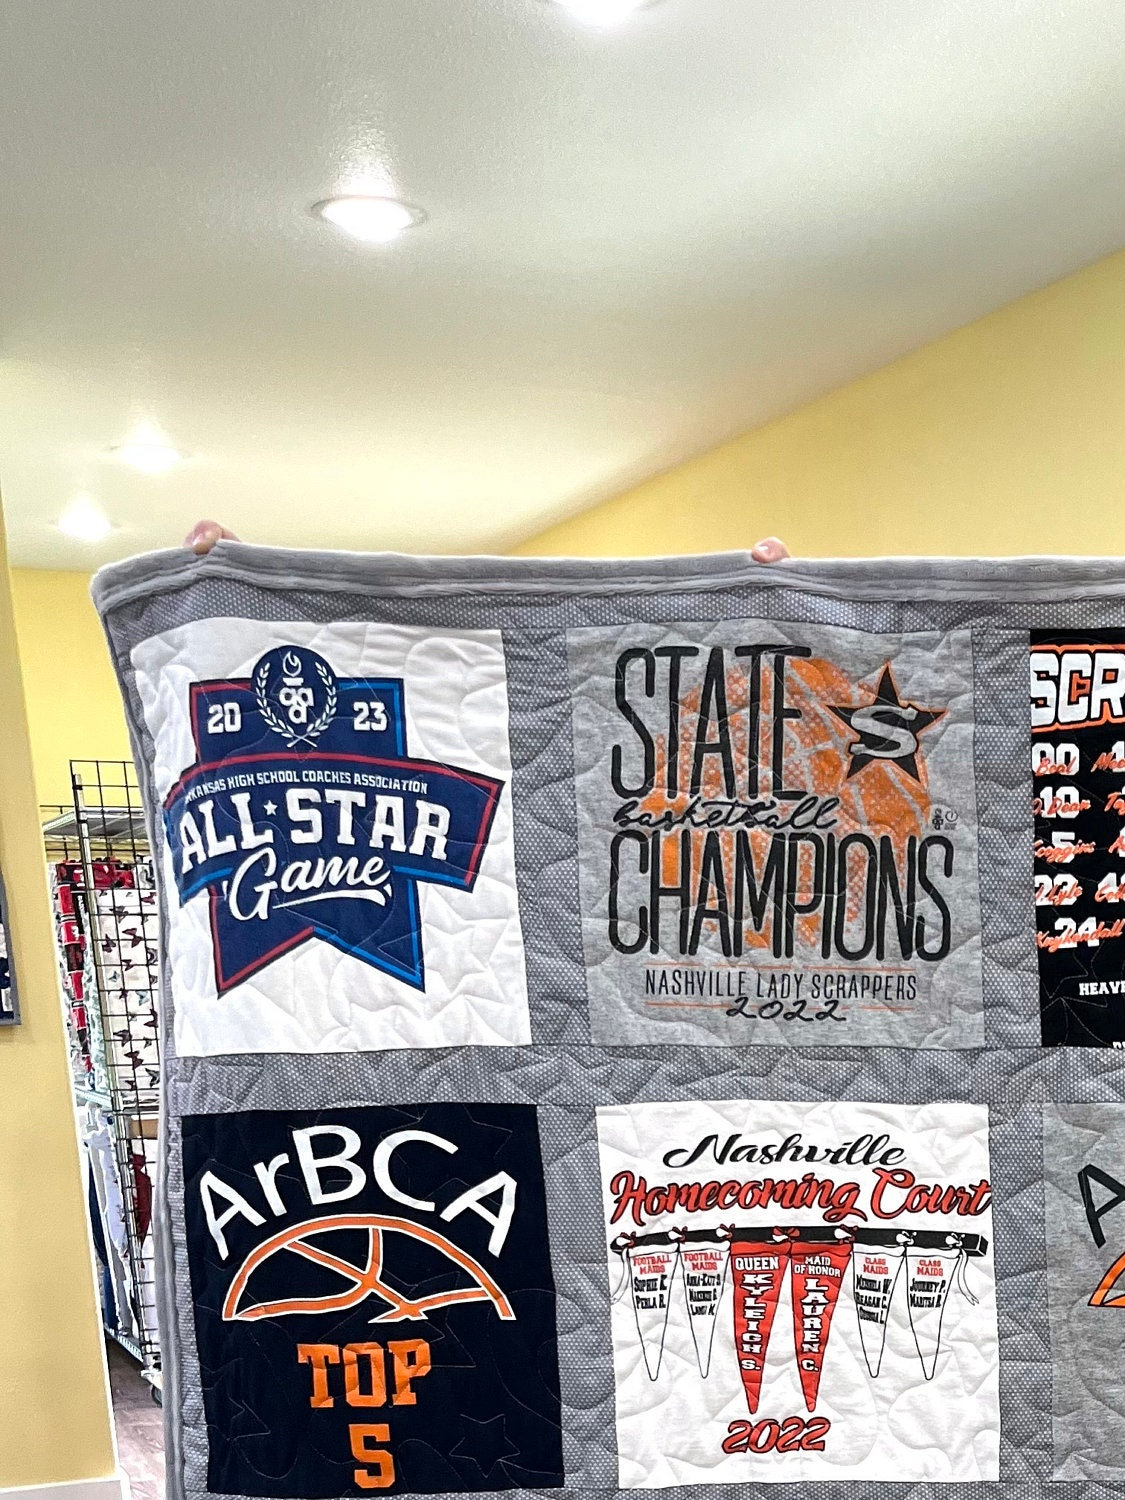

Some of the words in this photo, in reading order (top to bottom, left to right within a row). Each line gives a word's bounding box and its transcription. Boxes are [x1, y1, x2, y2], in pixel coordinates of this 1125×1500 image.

[207, 702, 242, 734] 20
[353, 701, 388, 732] 23
[611, 645, 812, 800] STATE
[227, 774, 256, 791] HIGH
[257, 770, 300, 785] SCHOOL
[302, 771, 351, 785] COACHES
[354, 773, 428, 795] ASSOCIATION
[613, 797, 840, 829] basketball
[1040, 786, 1080, 819] 10
[179, 792, 274, 874] ALL
[285, 788, 451, 862] STAR
[1051, 831, 1075, 864] 5
[228, 847, 392, 921] Game
[608, 830, 955, 961] CHAMPIONS
[1054, 916, 1100, 948] 24
[645, 969, 747, 997] NASHVILLE
[756, 973, 802, 999] LADY
[811, 973, 917, 1001] SCRAPPERS
[726, 996, 847, 1022] 2022
[662, 1133, 907, 1169] Nashville
[200, 1124, 518, 1261] ArBCA
[610, 1168, 868, 1227] Homecoming
[871, 1166, 992, 1219] Court
[735, 1256, 779, 1271] QUEEN
[794, 1265, 807, 1275] OF
[808, 1265, 841, 1277] HONOR
[805, 1256, 831, 1266] MAID
[740, 1273, 774, 1354] KYLEIGH
[801, 1278, 829, 1353] LAUREN
[297, 1338, 432, 1409] TOP
[721, 1416, 831, 1454] 2022
[348, 1423, 396, 1490] 5
